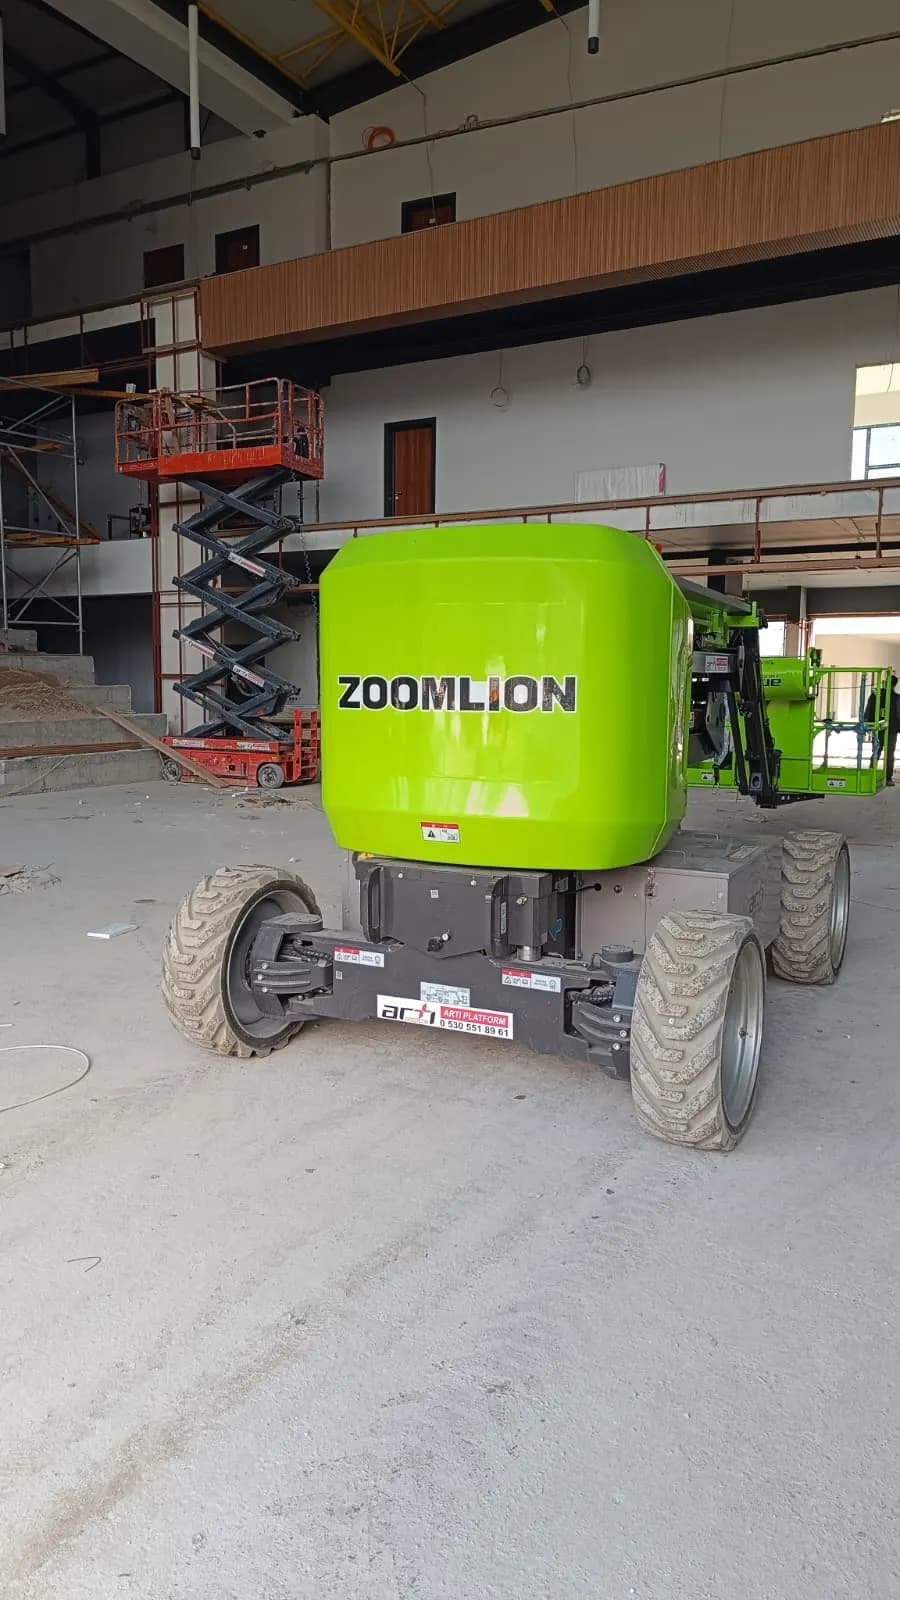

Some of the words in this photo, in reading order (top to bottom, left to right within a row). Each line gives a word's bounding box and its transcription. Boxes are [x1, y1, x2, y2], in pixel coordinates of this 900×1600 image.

[338, 675, 577, 713] ZOOMLION
[443, 1009, 462, 1019] ARTI
[463, 1011, 506, 1026] PLATFORM
[439, 1019, 446, 1028] 0
[447, 1020, 464, 1030] 530
[466, 1023, 482, 1033] 551
[484, 1026, 496, 1035] 89
[498, 1028, 509, 1037] 61
